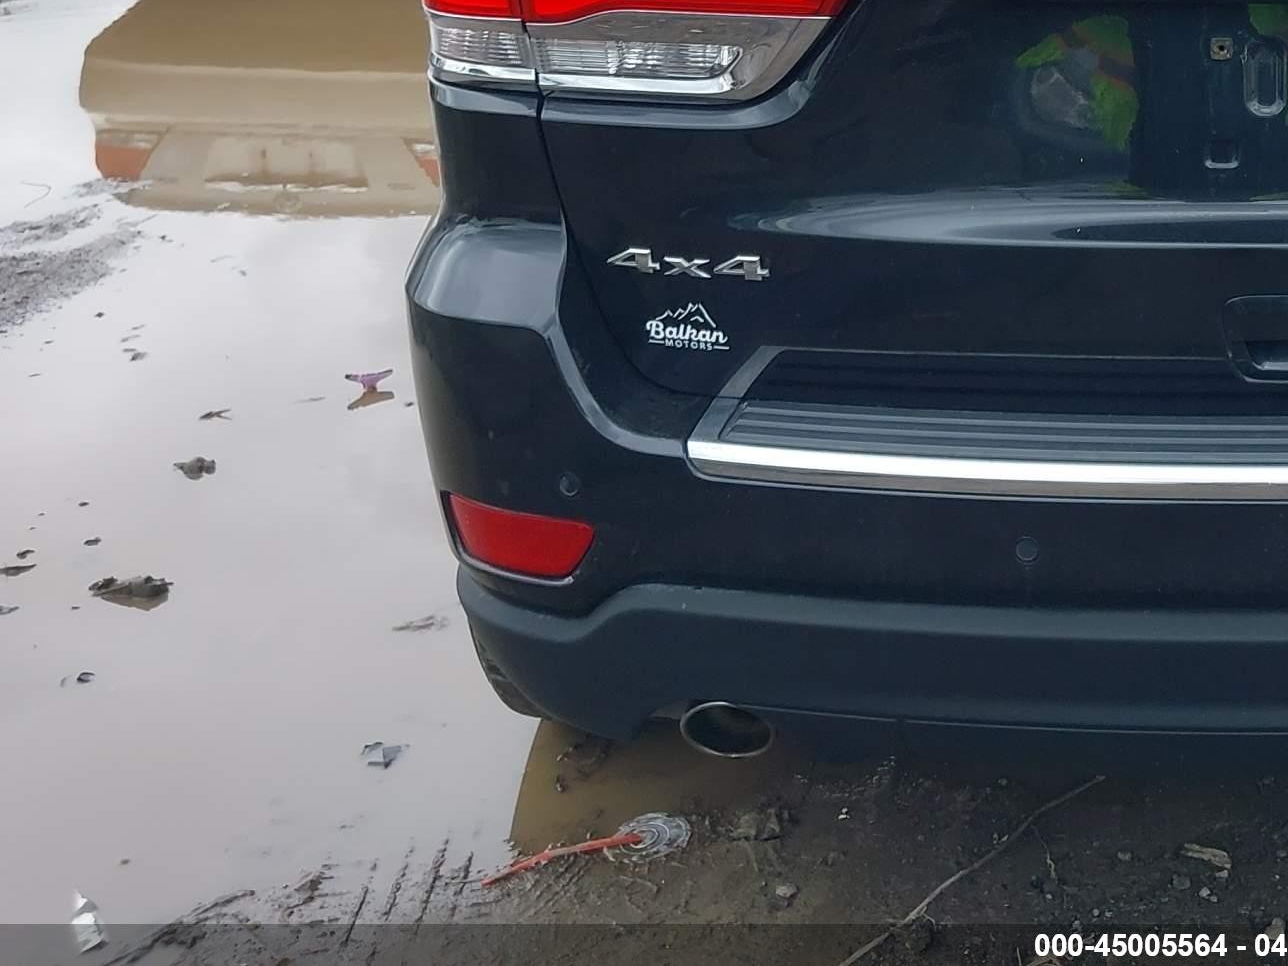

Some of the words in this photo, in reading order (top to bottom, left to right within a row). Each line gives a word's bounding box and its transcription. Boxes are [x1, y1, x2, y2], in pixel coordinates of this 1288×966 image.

[606, 247, 770, 282] 4x4
[645, 320, 729, 344] Balkan
[664, 338, 713, 351] MOTORS
